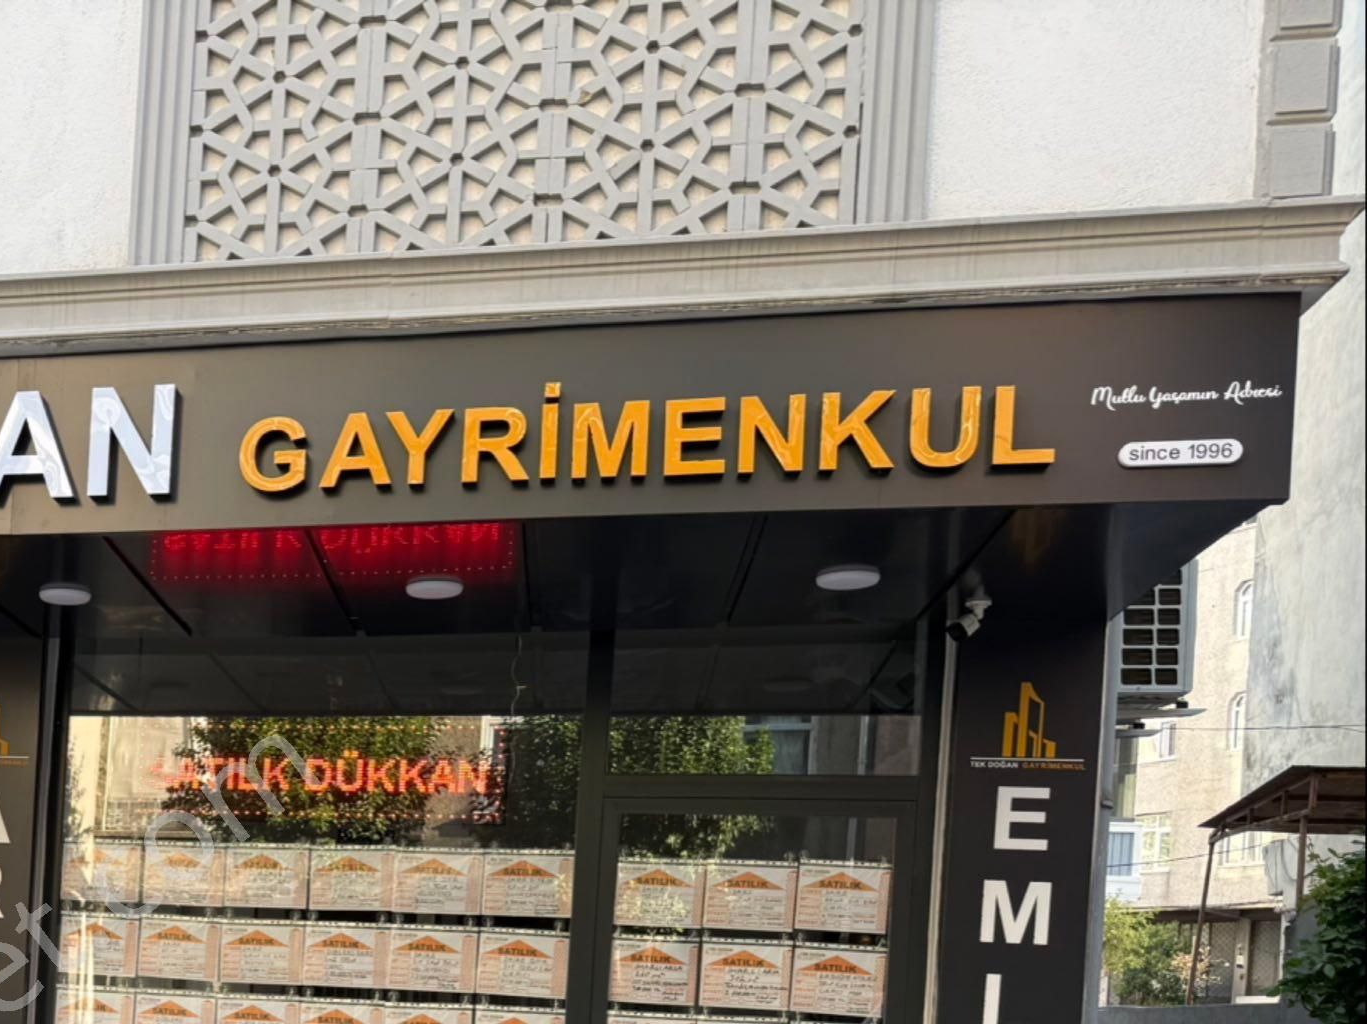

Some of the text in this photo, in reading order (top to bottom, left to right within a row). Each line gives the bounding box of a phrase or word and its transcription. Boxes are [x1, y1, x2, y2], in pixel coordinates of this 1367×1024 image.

[1090, 385, 1146, 411] Mutlu
[1224, 380, 1283, 405] Adresi
[238, 381, 1056, 493] GAYRİMENKUL
[1128, 442, 1234, 462] since 1996
[305, 750, 491, 794] DÜKKAN
[970, 760, 986, 768] TEK
[818, 879, 863, 890] SATILIK
[814, 962, 858, 973] SATILIK
